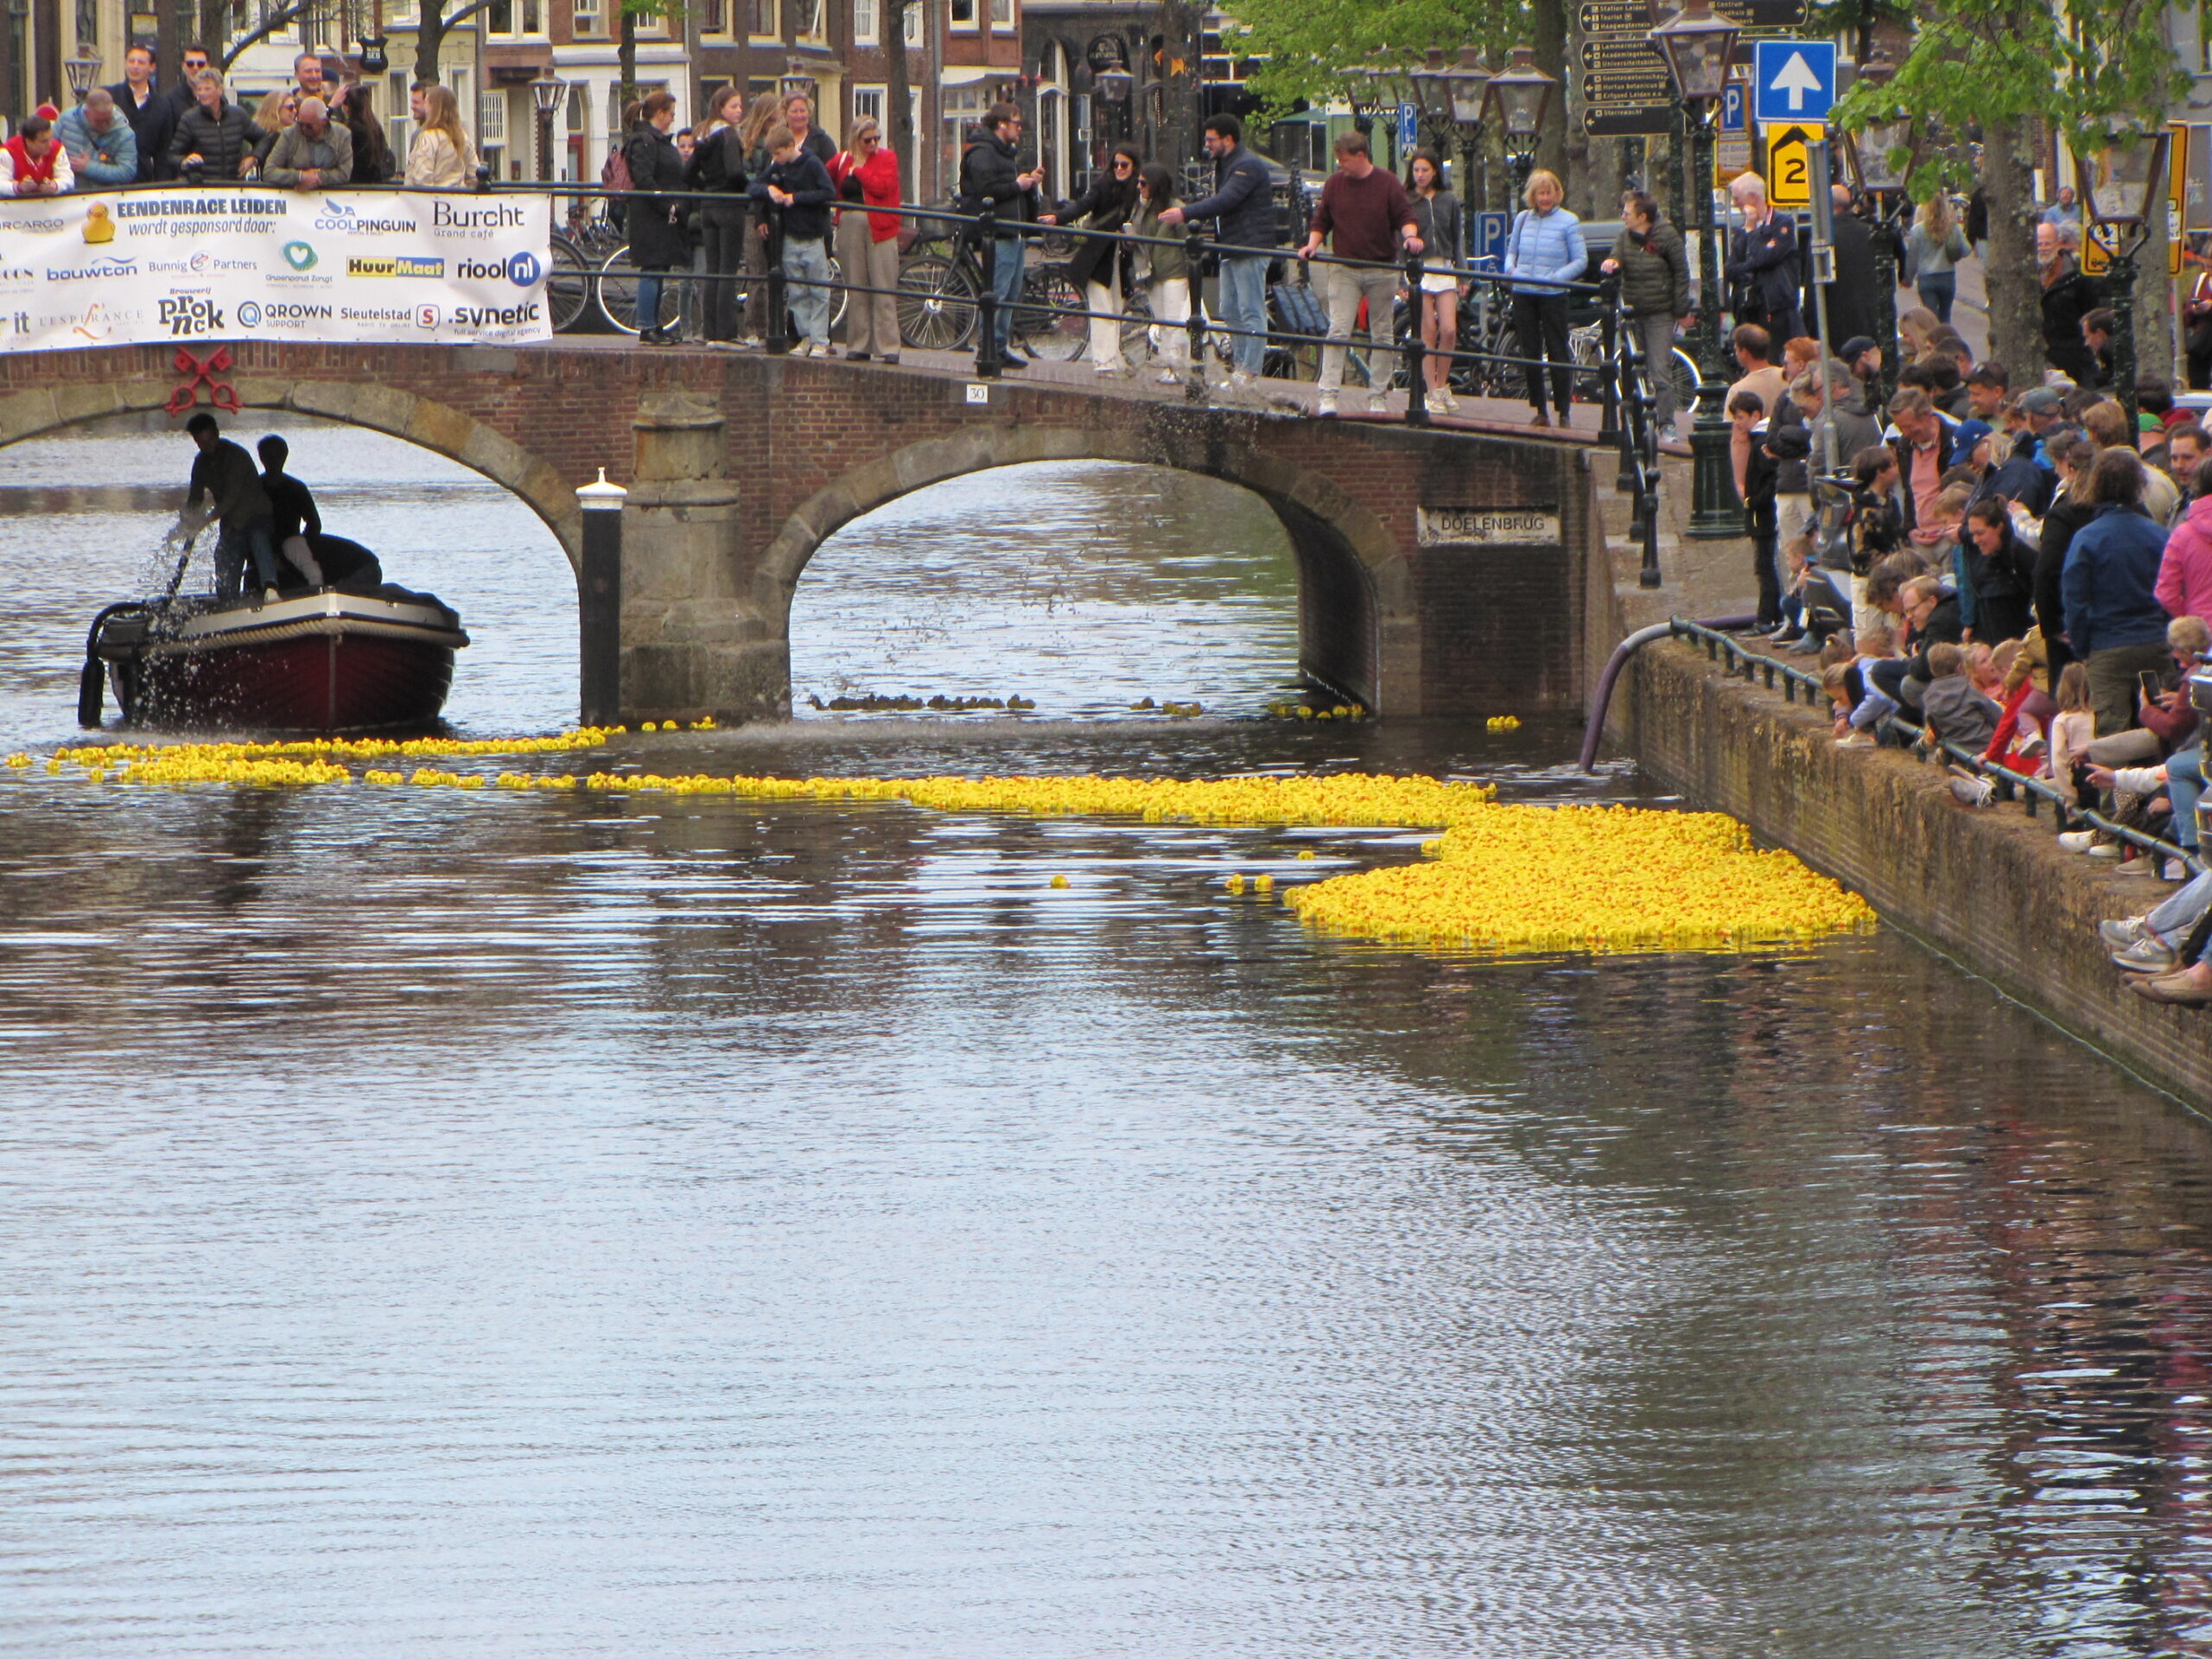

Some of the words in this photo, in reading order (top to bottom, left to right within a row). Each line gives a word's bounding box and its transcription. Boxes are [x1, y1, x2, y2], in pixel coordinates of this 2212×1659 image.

[1727, 90, 1739, 124] P
[1404, 105, 1413, 126] P
[1785, 159, 1805, 183] 2
[118, 199, 227, 218] EENDENRACE
[231, 199, 287, 215] LEIDEN
[433, 200, 525, 227] Burcht
[0, 219, 64, 230] RCARGO
[129, 218, 168, 236] wordt
[170, 217, 244, 238] gesponsord
[244, 217, 276, 234] door:
[315, 219, 416, 232] COOLPINGUIN
[434, 228, 466, 238] Grand
[470, 229, 494, 240] café
[1485, 218, 1501, 252] P
[47, 265, 137, 281] bouwton
[149, 260, 188, 273] Bunnig
[213, 259, 257, 270] Partners
[457, 257, 506, 278] riool
[515, 257, 533, 278] nl
[265, 304, 332, 319] QROWN
[341, 308, 411, 320] Sleutelstad
[266, 320, 306, 328] SUPPORT
[494, 327, 516, 337] digital
[517, 327, 541, 336] agency
[970, 388, 985, 399] 30
